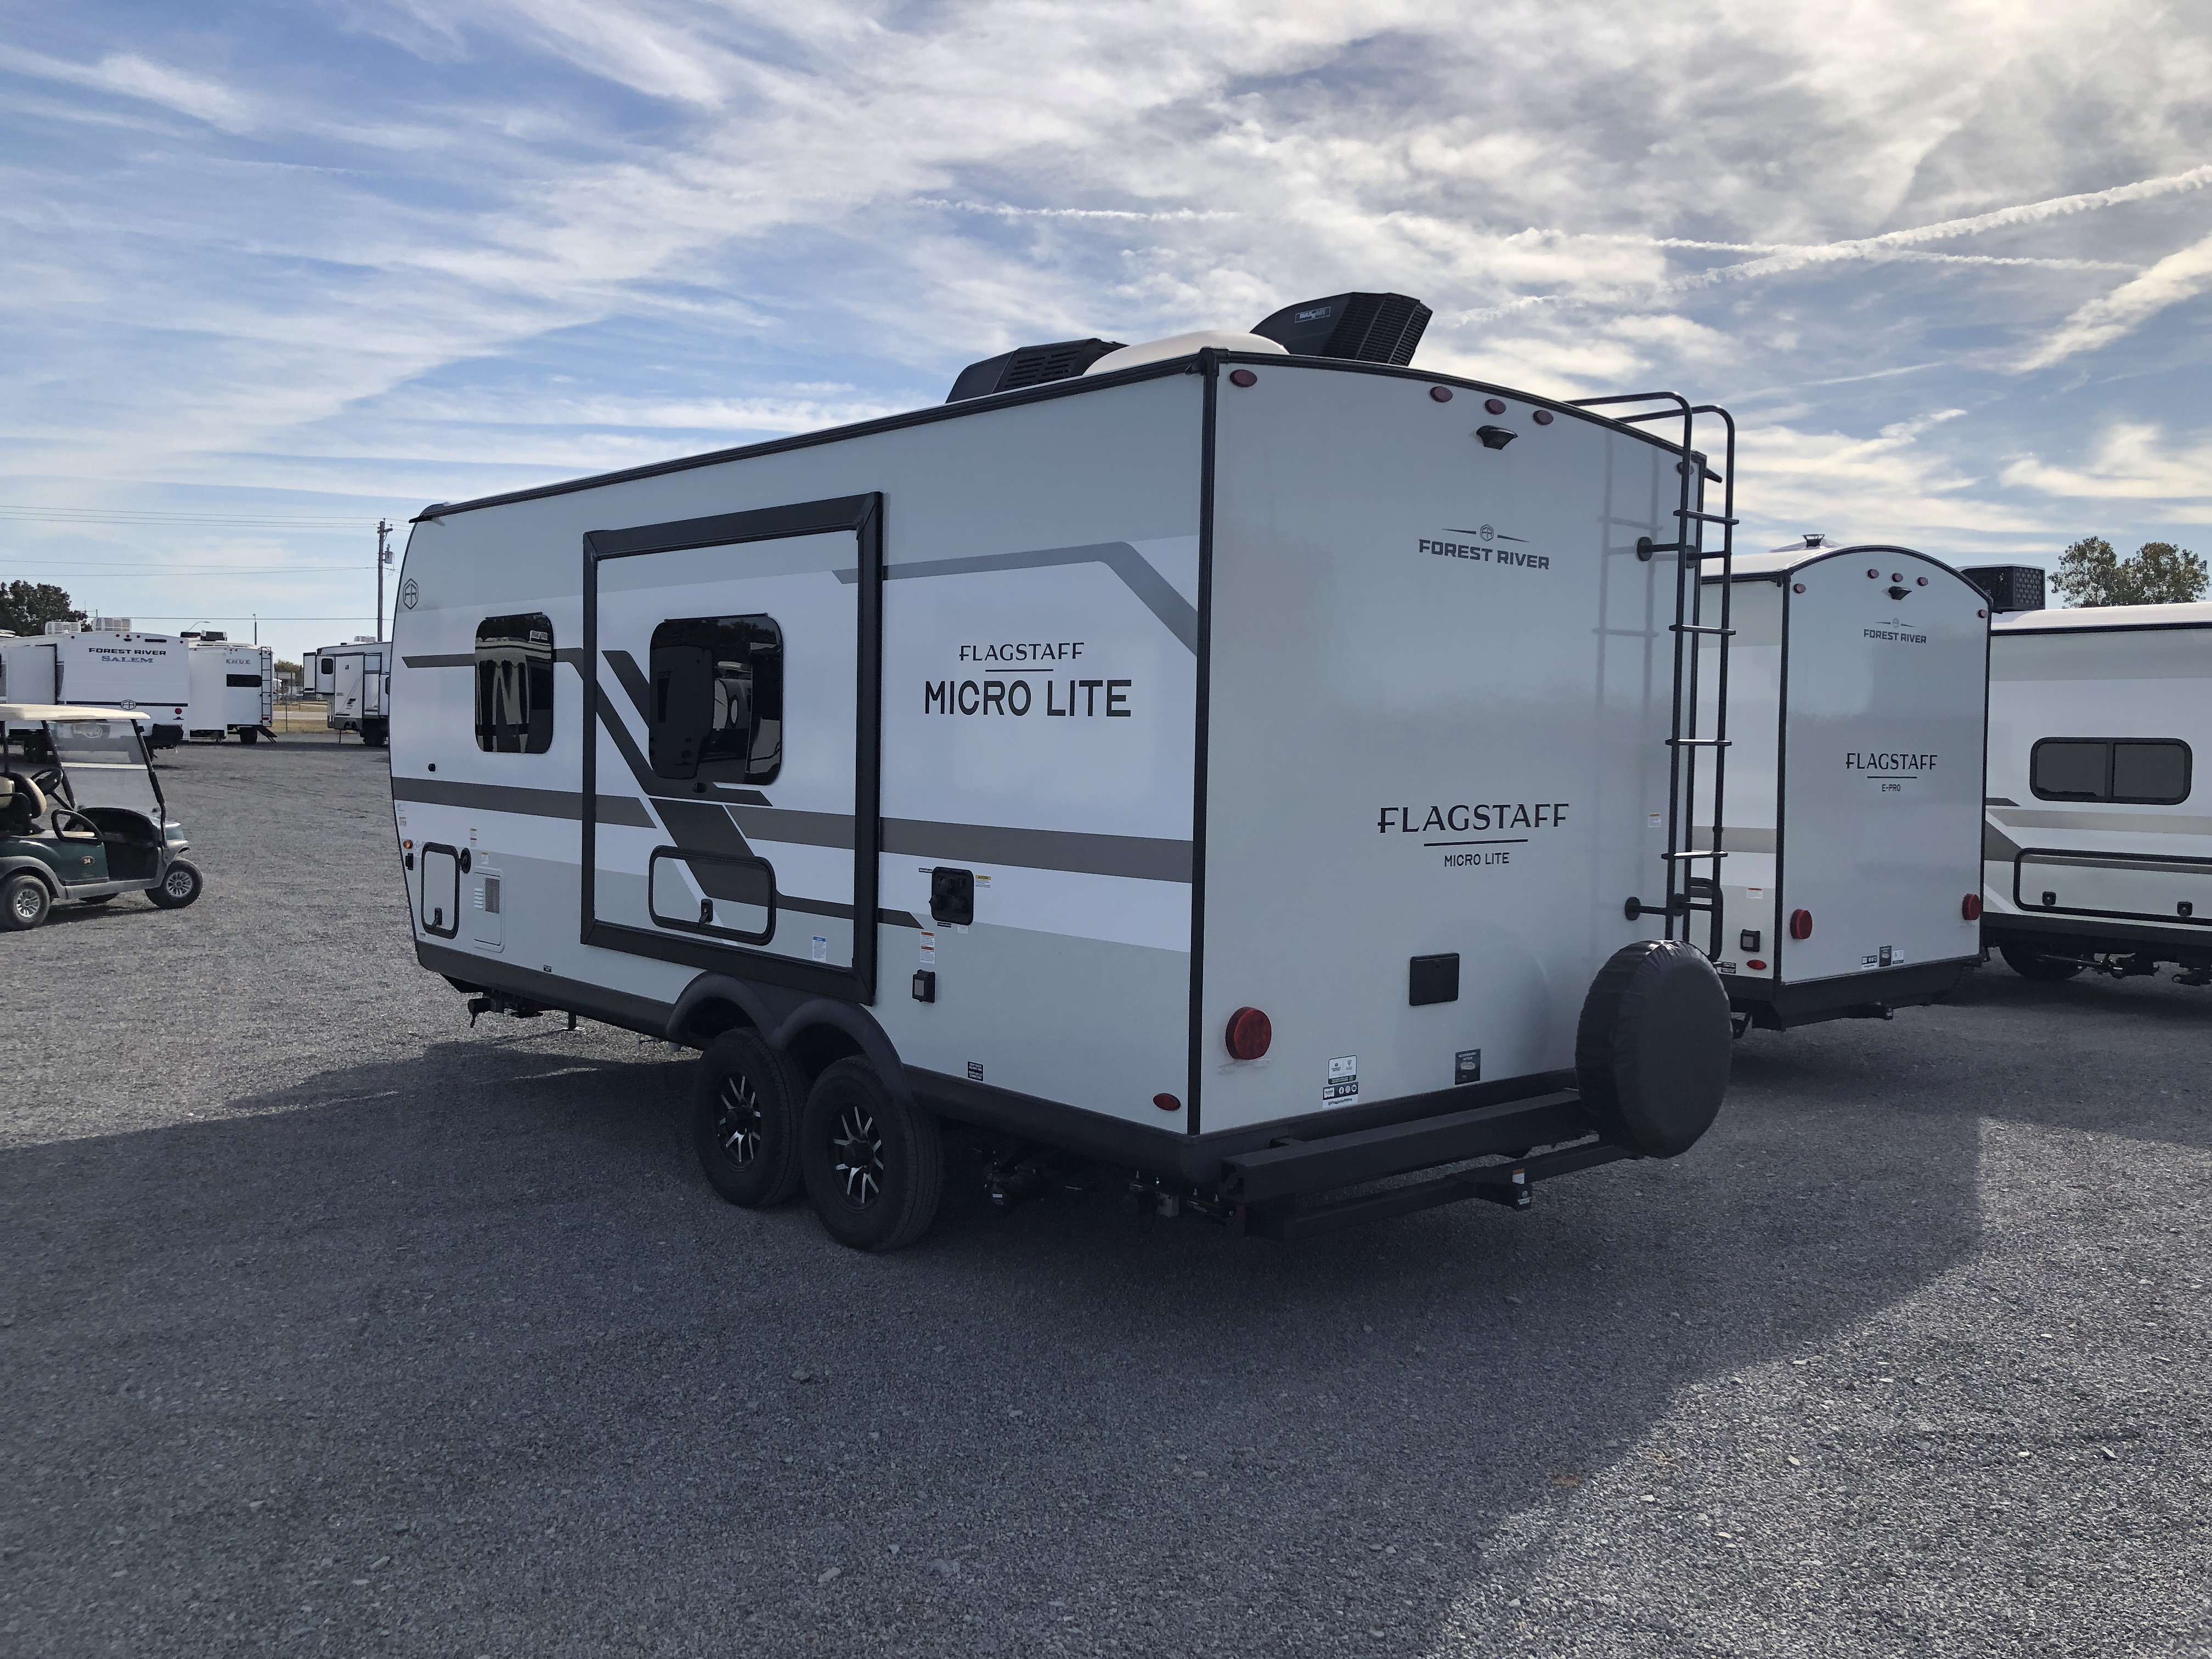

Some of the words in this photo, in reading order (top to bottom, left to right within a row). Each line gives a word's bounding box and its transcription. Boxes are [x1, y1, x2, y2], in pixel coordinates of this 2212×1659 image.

[1419, 539, 1493, 561] FOREST
[1497, 550, 1549, 569] RIVER
[1864, 629, 1899, 641] FOREST
[1900, 633, 1927, 644] RIVER
[959, 642, 1085, 661] FLAGSTAFF
[925, 680, 1031, 716] MICRO
[1047, 679, 1132, 716] LITE
[1846, 753, 1938, 770] FLAGSTAFF
[1377, 803, 1569, 833] FLAGSTAFF
[1444, 853, 1481, 867] MICRO
[1485, 852, 1510, 865] LITE
